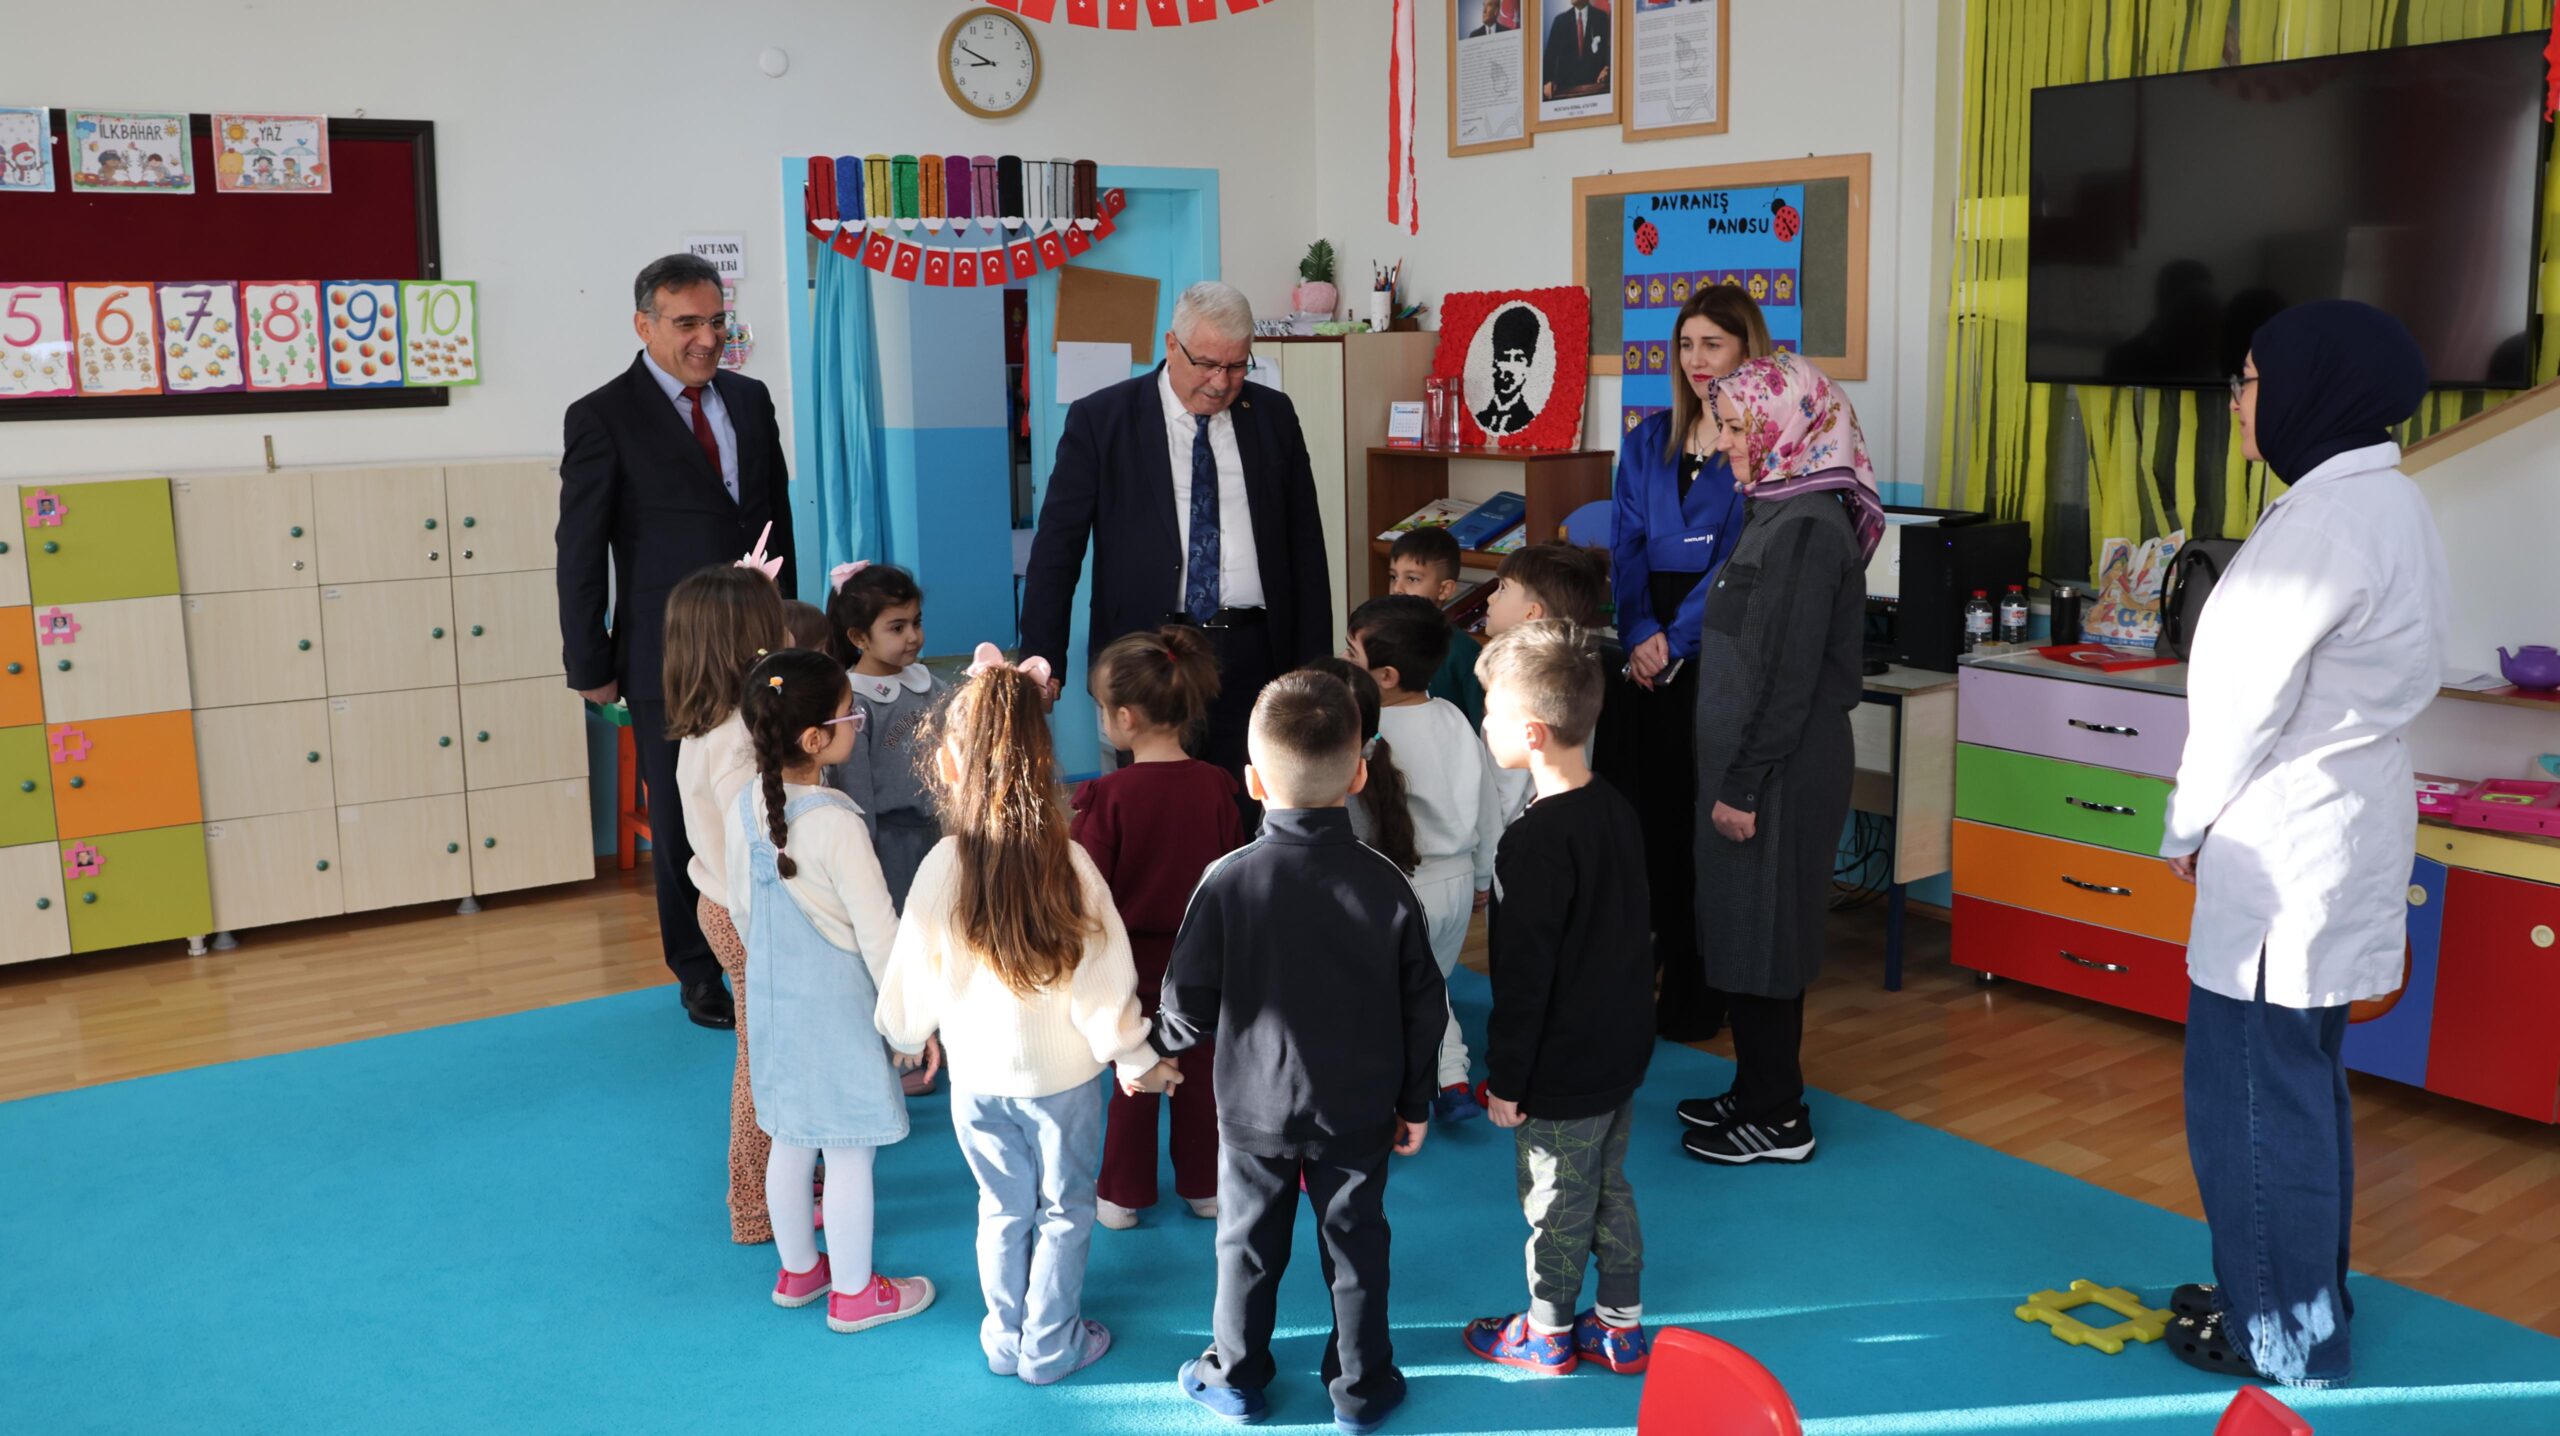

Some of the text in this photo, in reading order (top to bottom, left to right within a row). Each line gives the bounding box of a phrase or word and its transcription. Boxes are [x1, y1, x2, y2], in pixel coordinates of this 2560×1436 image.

[984, 20, 994, 30] 12
[969, 26, 977, 35] 11
[1003, 27, 1008, 36] 1
[958, 39, 968, 49] 10
[1015, 41, 1021, 50] 2
[953, 57, 960, 67] 9
[1020, 60, 1027, 69] 3
[959, 76, 966, 86] 8
[1016, 78, 1022, 87] 4
[972, 90, 978, 100] 7
[1005, 91, 1011, 100] 5
[988, 96, 995, 105] 6
[259, 126, 282, 141] YAZ
[1651, 193, 1729, 214] DAVRANIŞ
[1708, 217, 1769, 234] PANOSU
[690, 243, 739, 255] HAFTANIN
[181, 289, 213, 341] 7
[262, 290, 302, 343] 8
[346, 289, 378, 341] 9
[416, 288, 461, 336] 10
[3, 291, 42, 347] 5
[95, 290, 134, 346] 6
